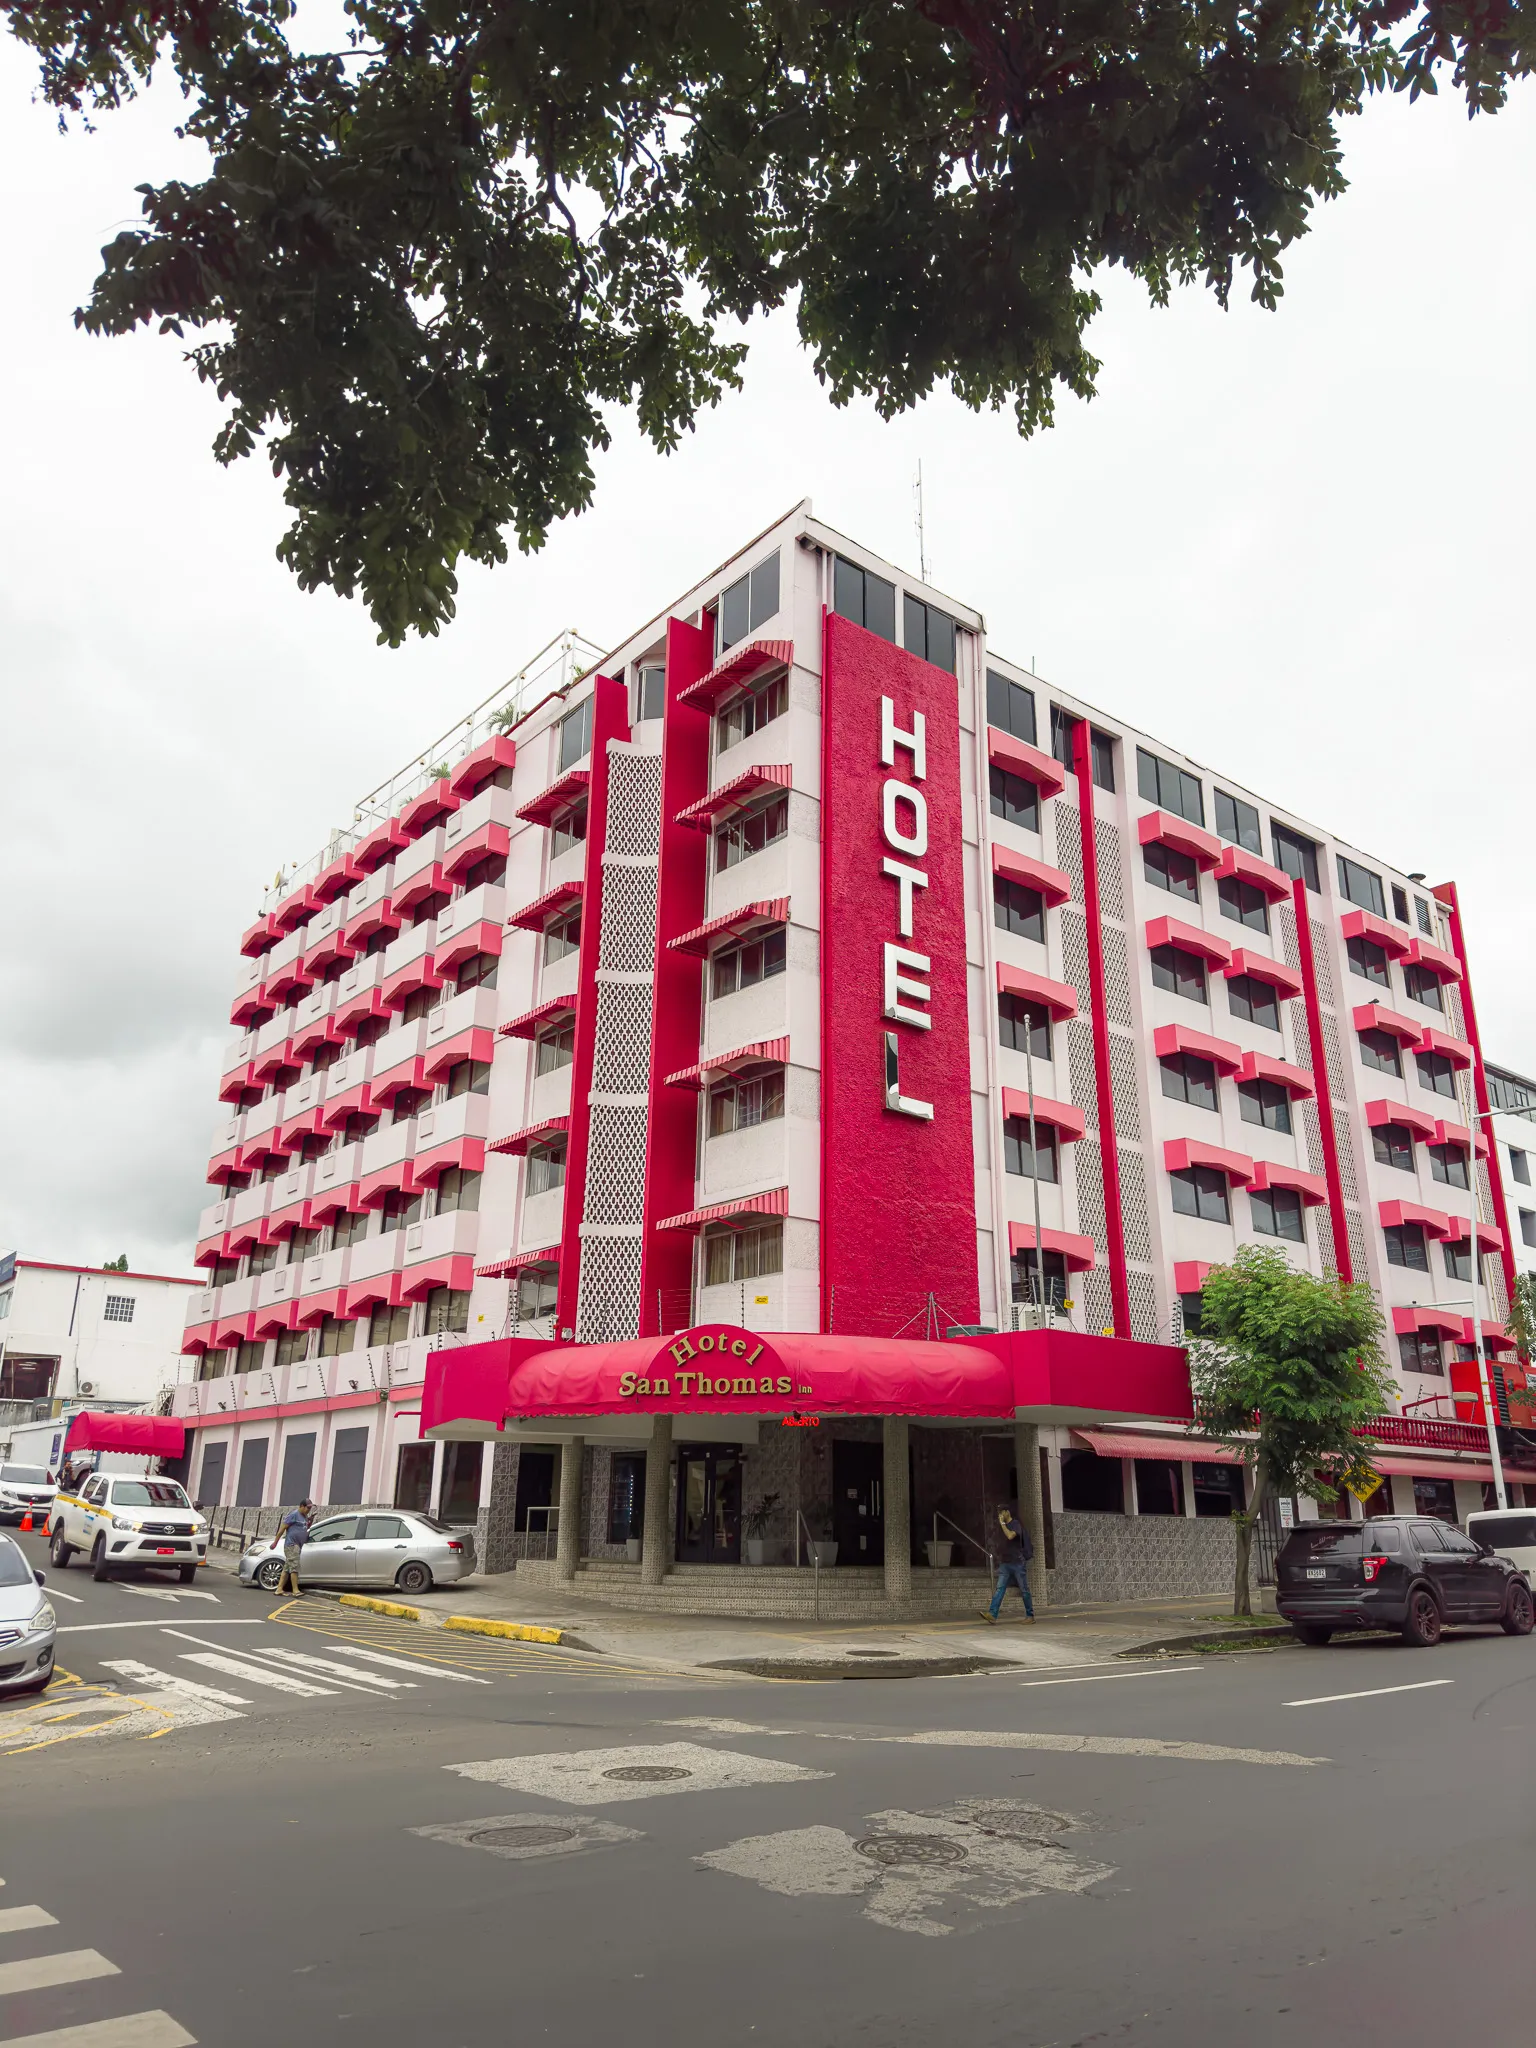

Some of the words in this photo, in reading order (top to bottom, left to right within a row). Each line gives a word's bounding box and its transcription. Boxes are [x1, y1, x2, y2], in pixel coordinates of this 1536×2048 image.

[879, 695, 934, 1121] HOTEL
[667, 1332, 765, 1367] Hotel
[618, 1371, 671, 1397] San
[674, 1371, 793, 1396] Thomas
